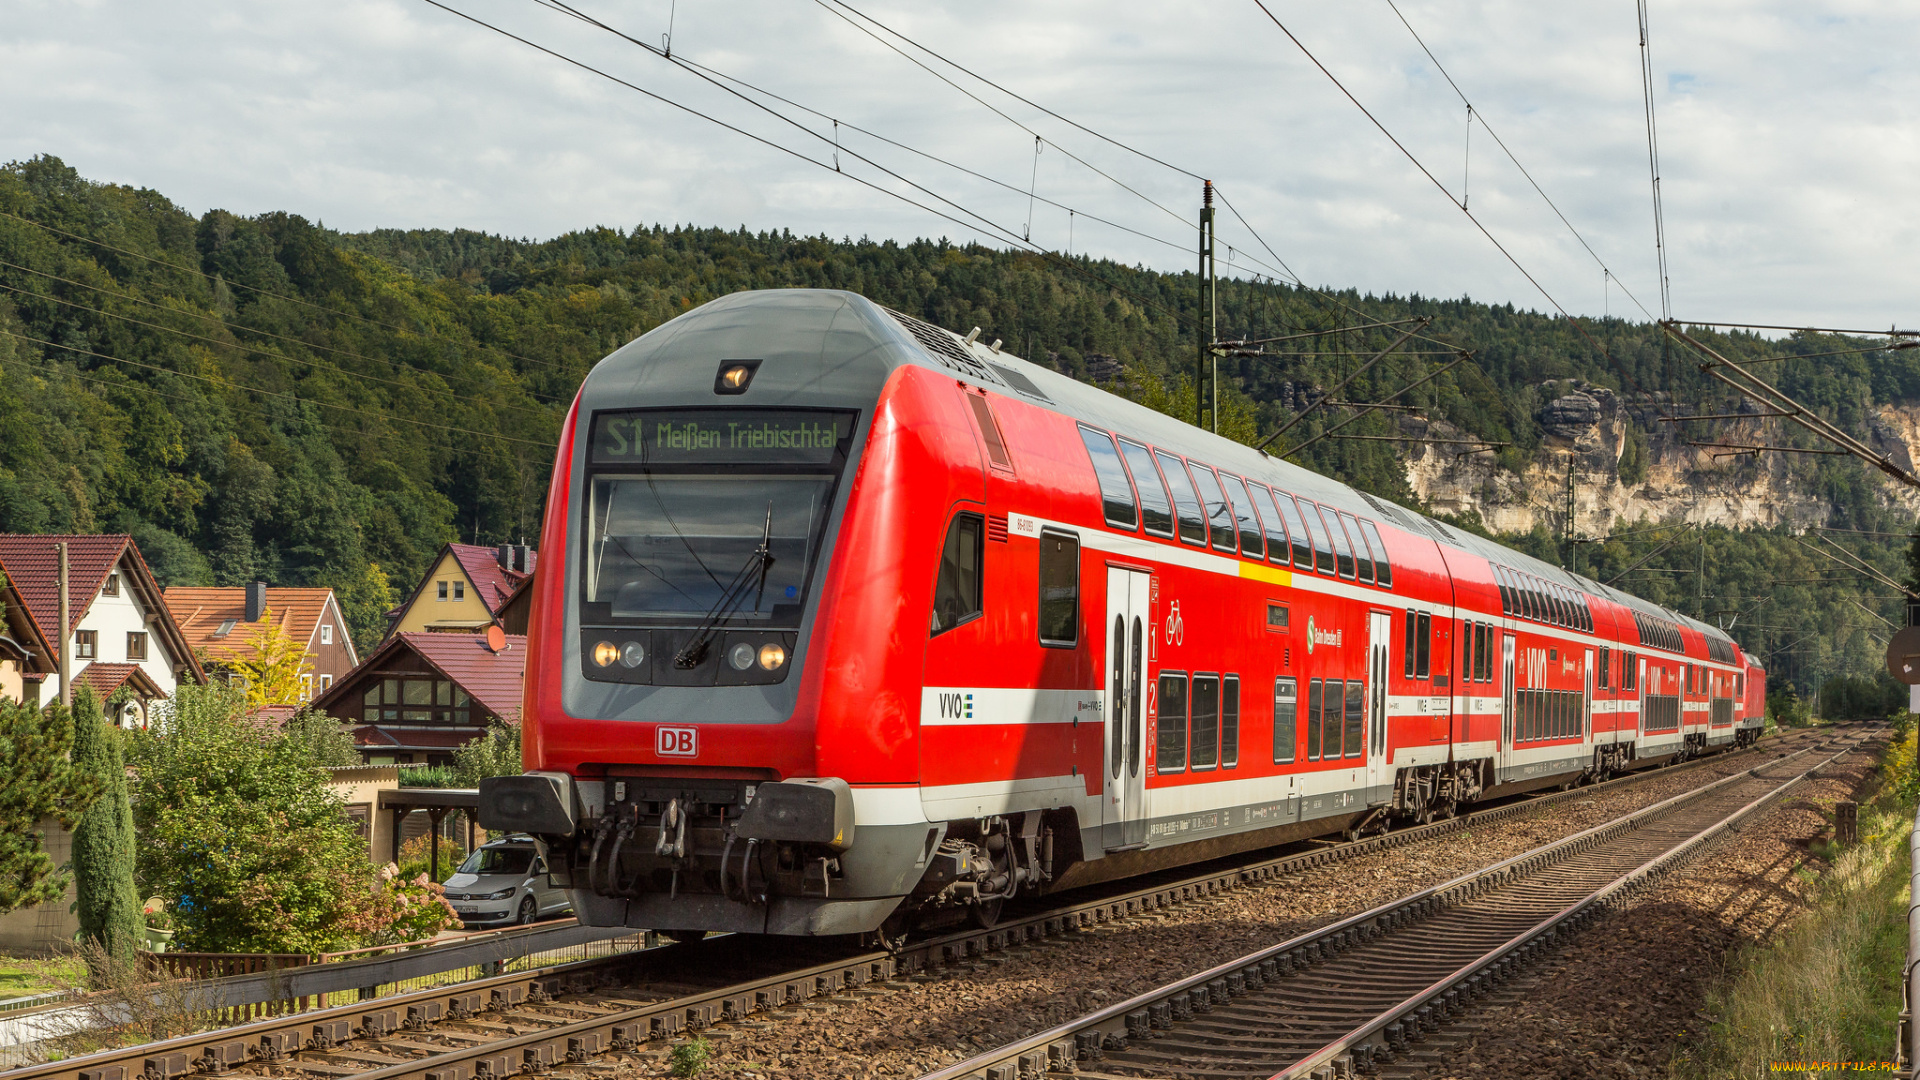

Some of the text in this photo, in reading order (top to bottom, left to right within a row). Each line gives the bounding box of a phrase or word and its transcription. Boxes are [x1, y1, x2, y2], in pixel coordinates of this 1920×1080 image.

[606, 418, 837, 456] S1 Meißen Triebischtal
[1151, 626, 1156, 659] 1
[939, 692, 962, 719] VVO
[1149, 683, 1155, 715] 2
[661, 730, 693, 752] DB
[1837, 804, 1857, 819] 36
